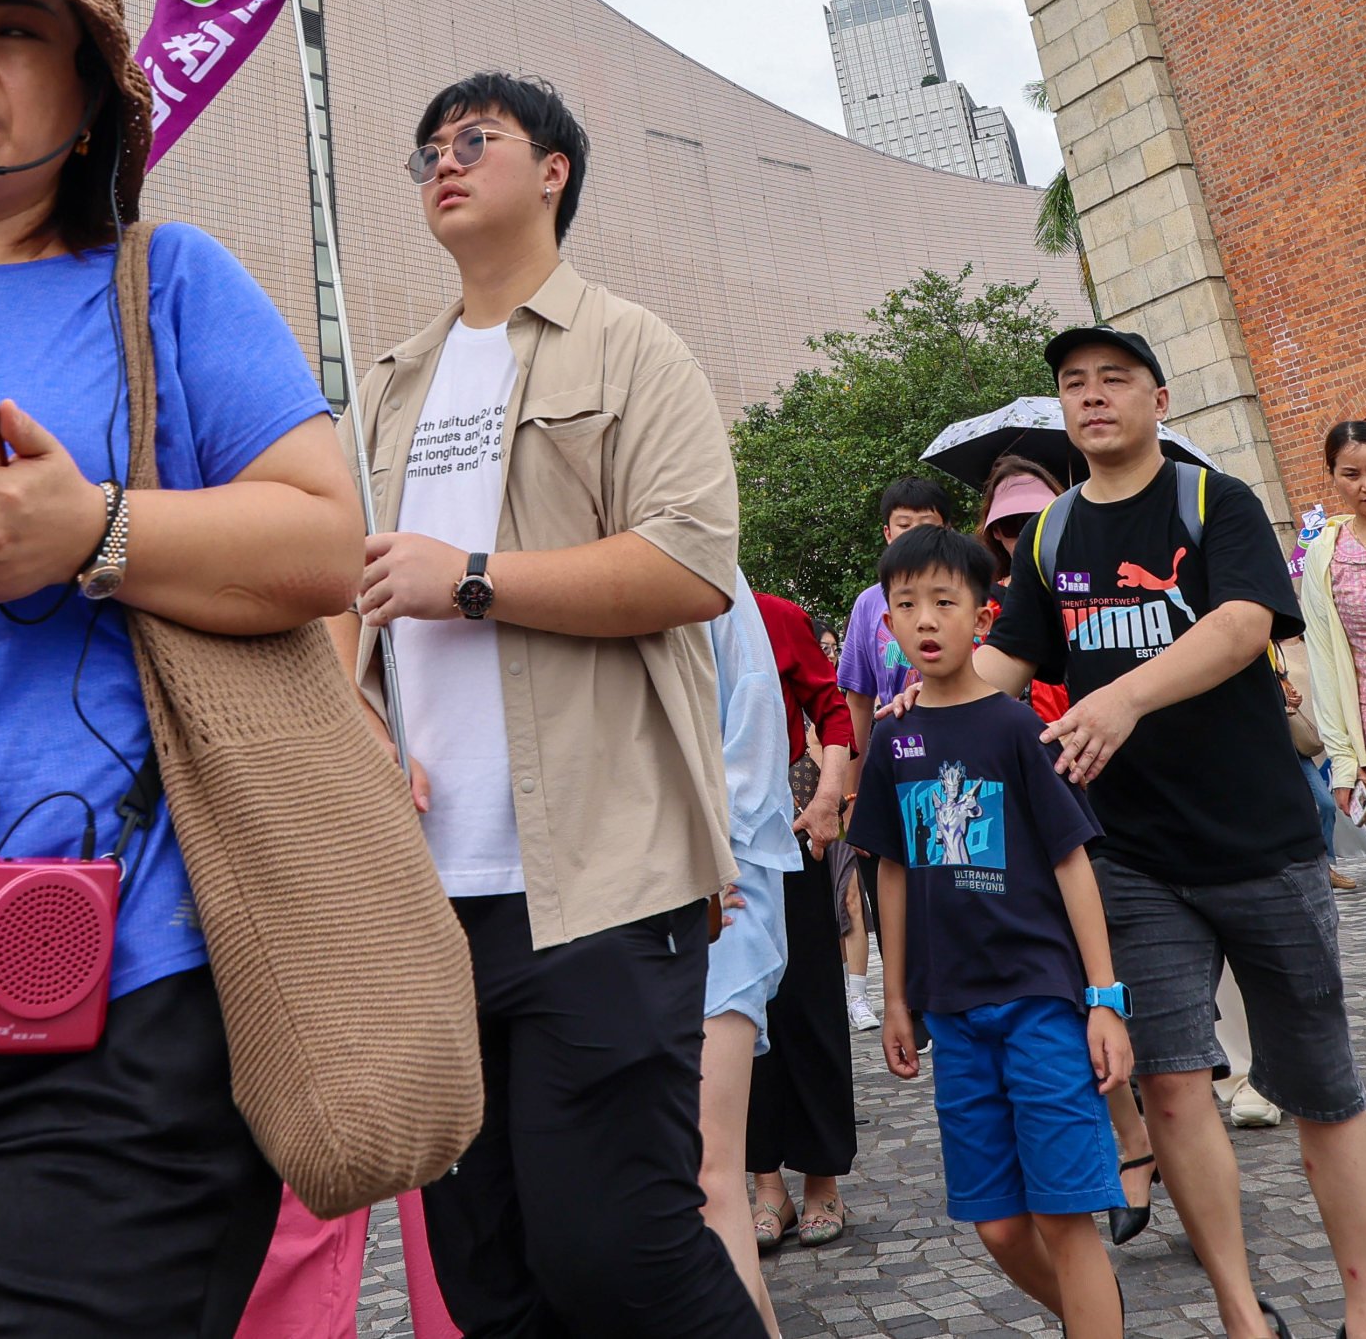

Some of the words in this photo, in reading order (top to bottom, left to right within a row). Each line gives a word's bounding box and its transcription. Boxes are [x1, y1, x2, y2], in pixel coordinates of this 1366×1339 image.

[416, 432, 461, 447] minutes
[425, 444, 478, 461] longitude
[407, 463, 453, 479] minutes
[456, 457, 479, 471] and
[1058, 573, 1067, 592] 3
[1089, 596, 1141, 606] SPORTSWEAR
[1061, 600, 1174, 652] PUMA
[892, 739, 903, 759] 3
[954, 869, 1004, 883] ULTRAMAN
[969, 880, 1005, 893] BEYOND
